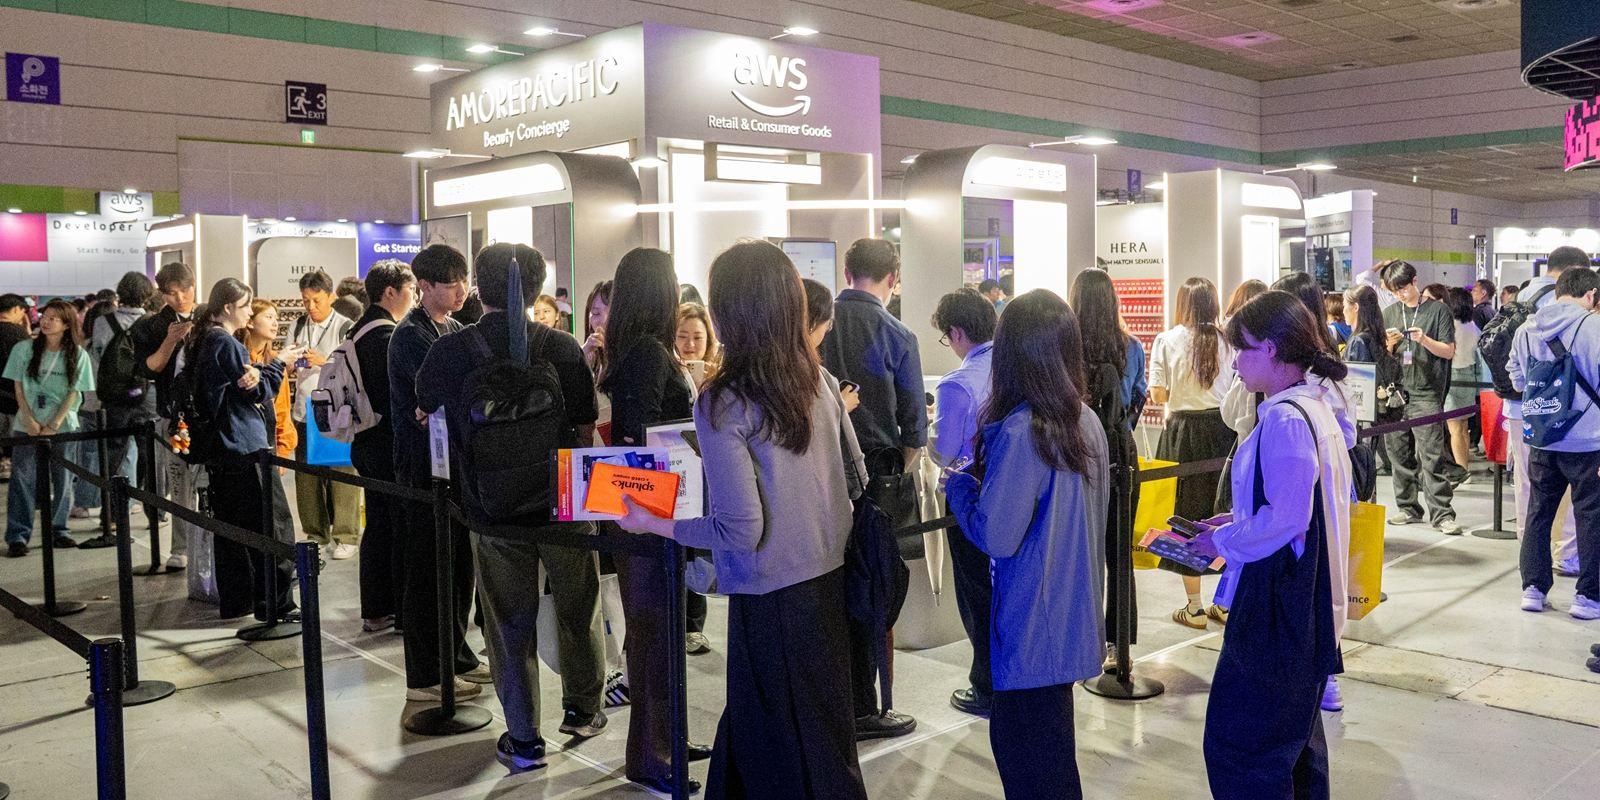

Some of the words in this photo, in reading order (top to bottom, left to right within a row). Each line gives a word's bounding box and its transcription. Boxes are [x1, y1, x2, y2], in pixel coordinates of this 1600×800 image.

[733, 51, 808, 91] aws
[446, 56, 619, 131] AMOREPACIFIC
[316, 93, 327, 110] 3
[308, 111, 326, 119] EXIT
[483, 129, 515, 147] Beauty
[516, 118, 571, 139] Concierge
[707, 115, 739, 130] Retail
[741, 118, 751, 131] &
[750, 119, 801, 135] Consumer
[801, 124, 832, 138] Goods
[111, 194, 143, 205] aws
[53, 220, 133, 232] Developer
[374, 242, 390, 253] Get
[1110, 241, 1148, 253] HERA
